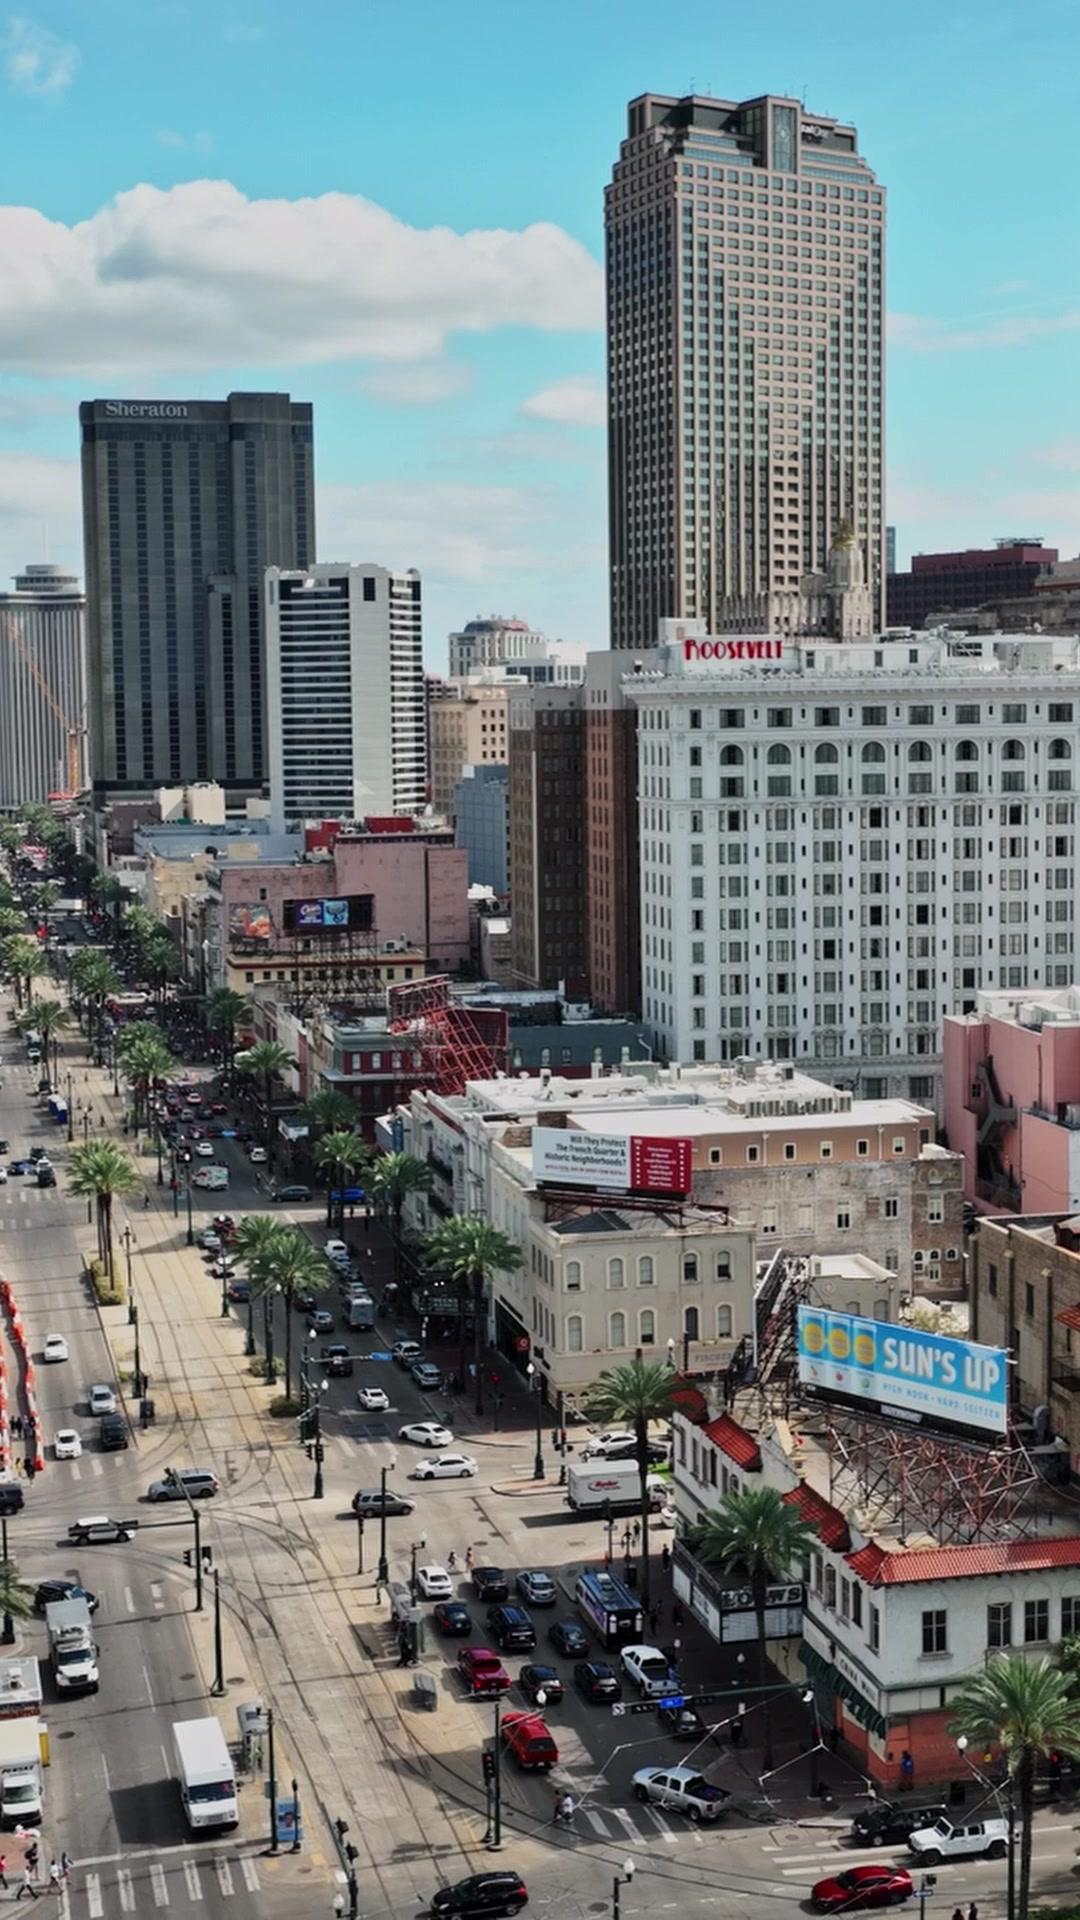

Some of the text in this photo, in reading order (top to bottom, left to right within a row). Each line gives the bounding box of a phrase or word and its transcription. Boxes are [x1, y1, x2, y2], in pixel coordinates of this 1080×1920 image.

[105, 401, 188, 417] Sheraton
[684, 639, 783, 660] ROOSEVELT
[556, 1143, 568, 1151] The
[568, 1145, 592, 1154] French
[593, 1147, 619, 1156] Quarter
[584, 1136, 599, 1146] They
[600, 1138, 626, 1147] Protect
[544, 1152, 626, 1167] Historic Neighborhoods?
[882, 1337, 999, 1393] SUN'S UP
[882, 1382, 1000, 1420] HIGH NOON HARD SELTZER
